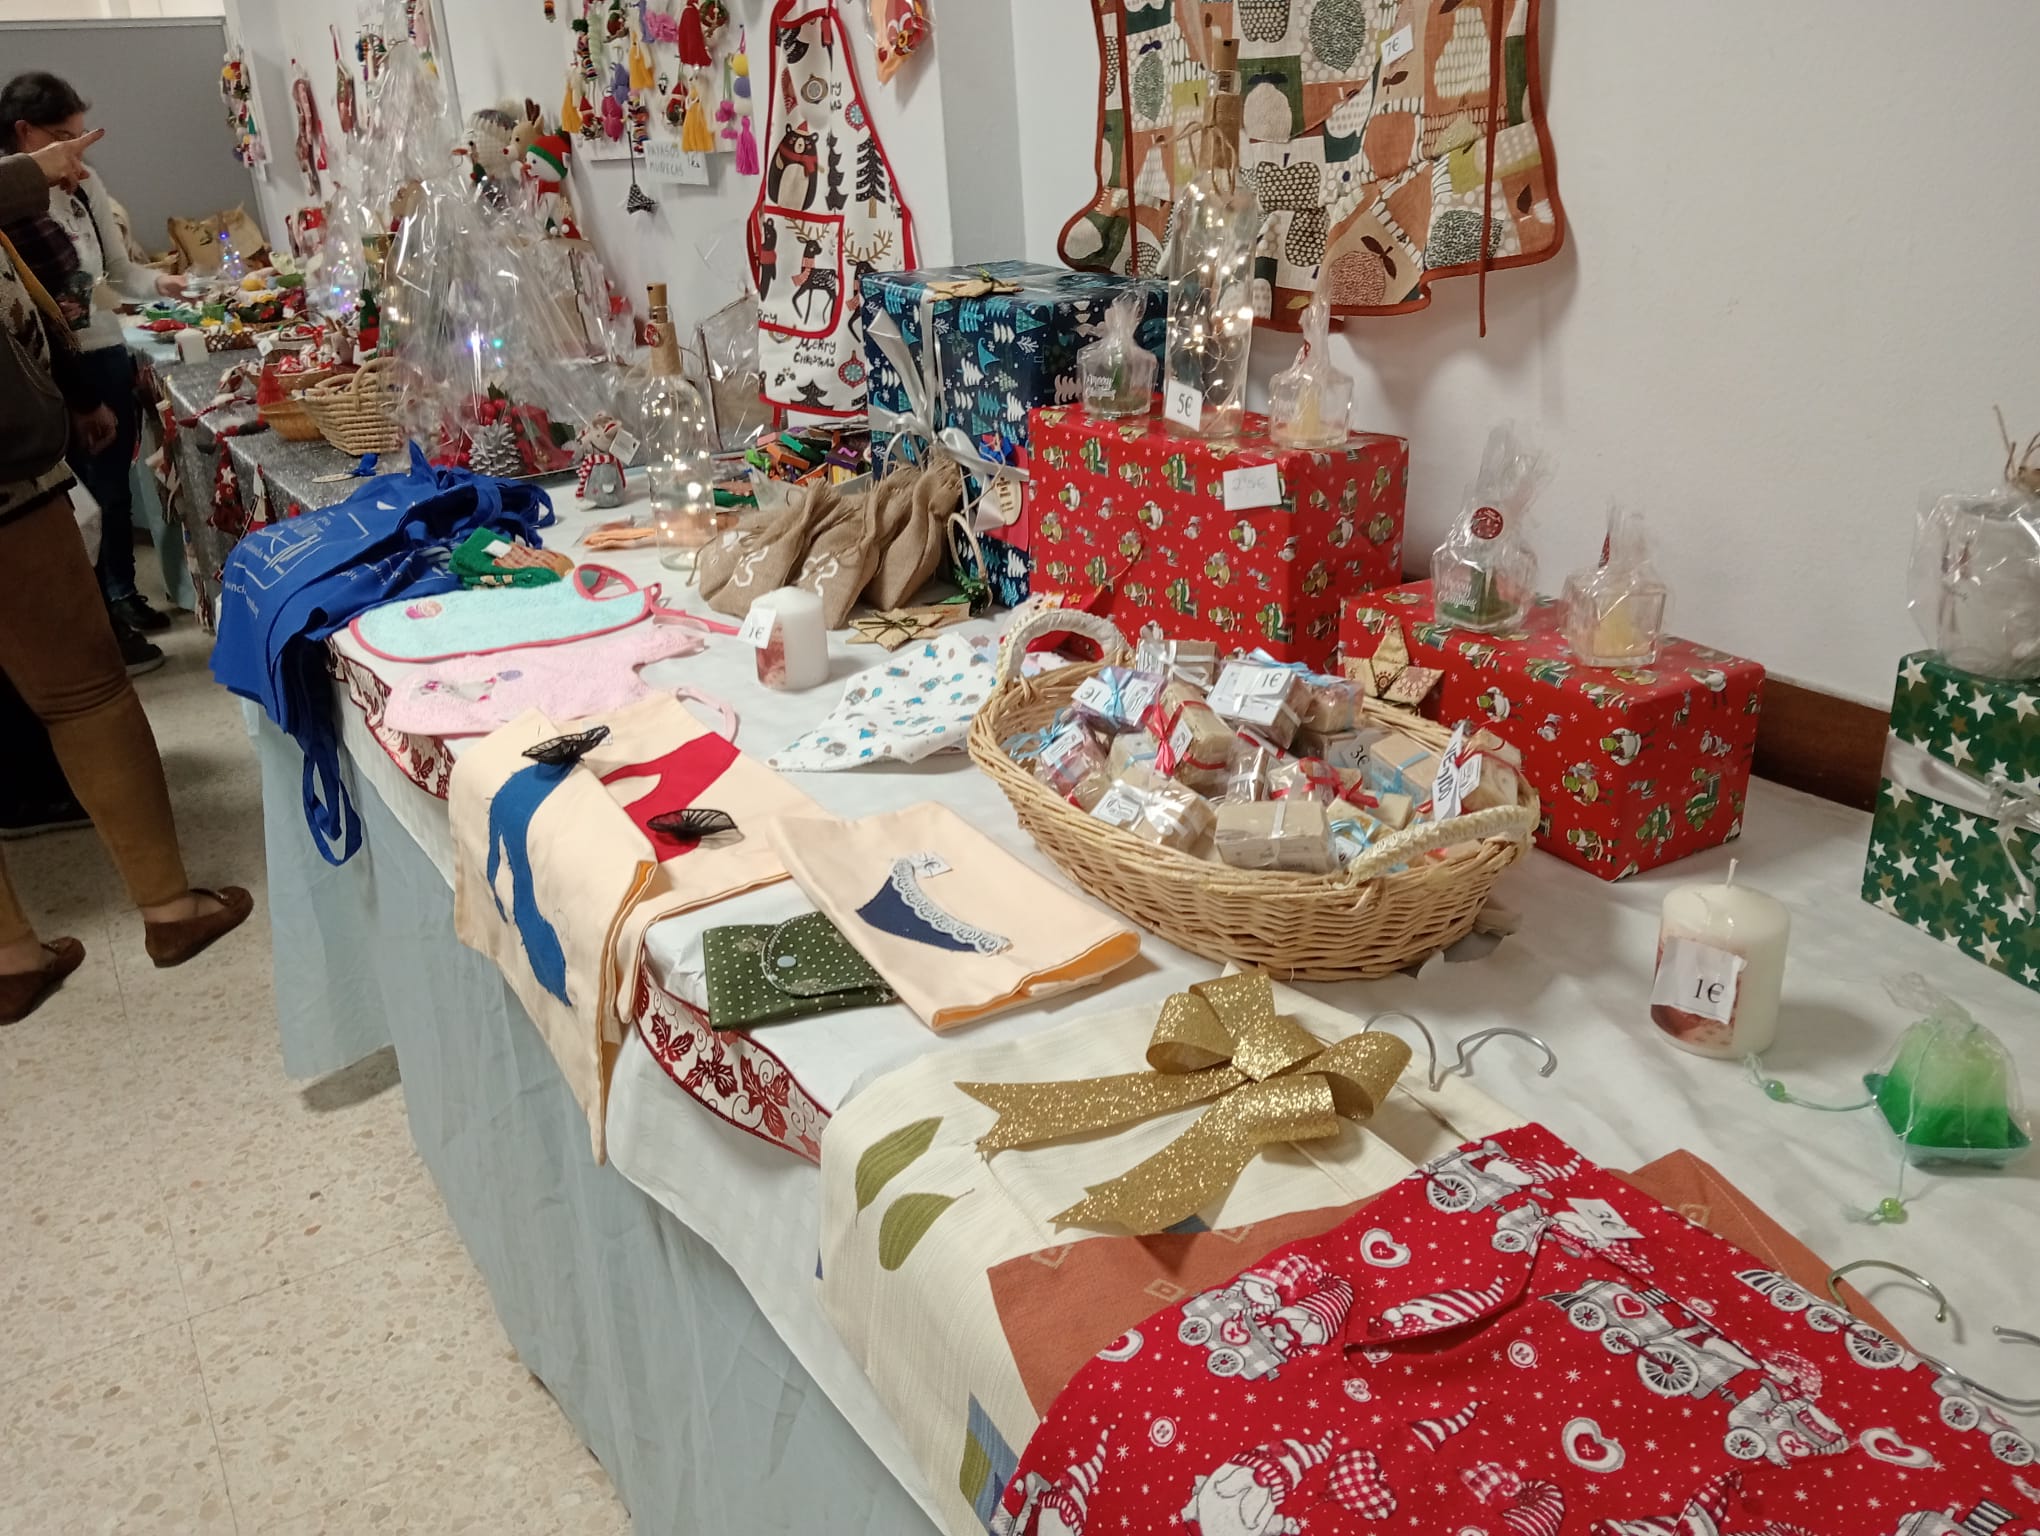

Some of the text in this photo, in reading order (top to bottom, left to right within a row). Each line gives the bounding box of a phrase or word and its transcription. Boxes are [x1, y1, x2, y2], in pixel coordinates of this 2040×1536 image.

[1385, 37, 1400, 57] 7€
[1177, 393, 1194, 418] 5€
[749, 626, 765, 640] 1€
[1262, 672, 1282, 688] 1€
[1693, 979, 1725, 1004] 1€
